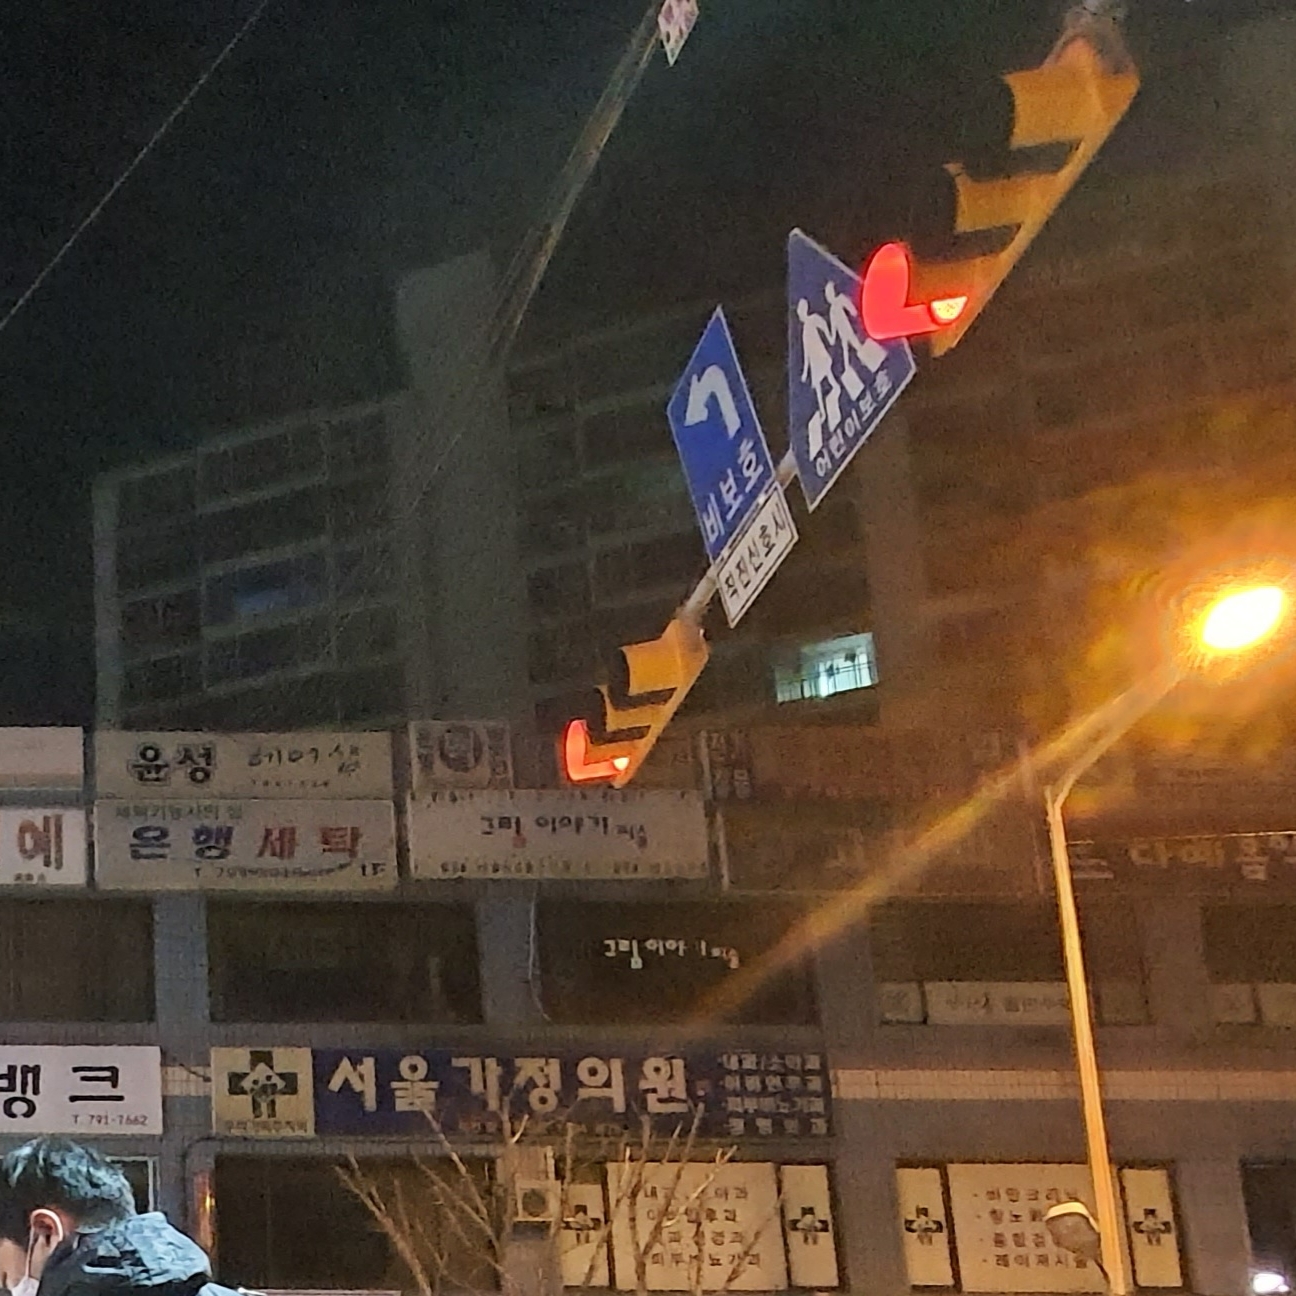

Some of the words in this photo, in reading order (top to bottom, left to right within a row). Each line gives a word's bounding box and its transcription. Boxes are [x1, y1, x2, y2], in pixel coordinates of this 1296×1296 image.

[814, 368, 893, 478] 어린이보호
[702, 438, 764, 543] 비보호
[724, 503, 786, 598] 직진신호시
[128, 824, 361, 861] 은행세탁
[327, 1055, 689, 1113] 서울가정의원
